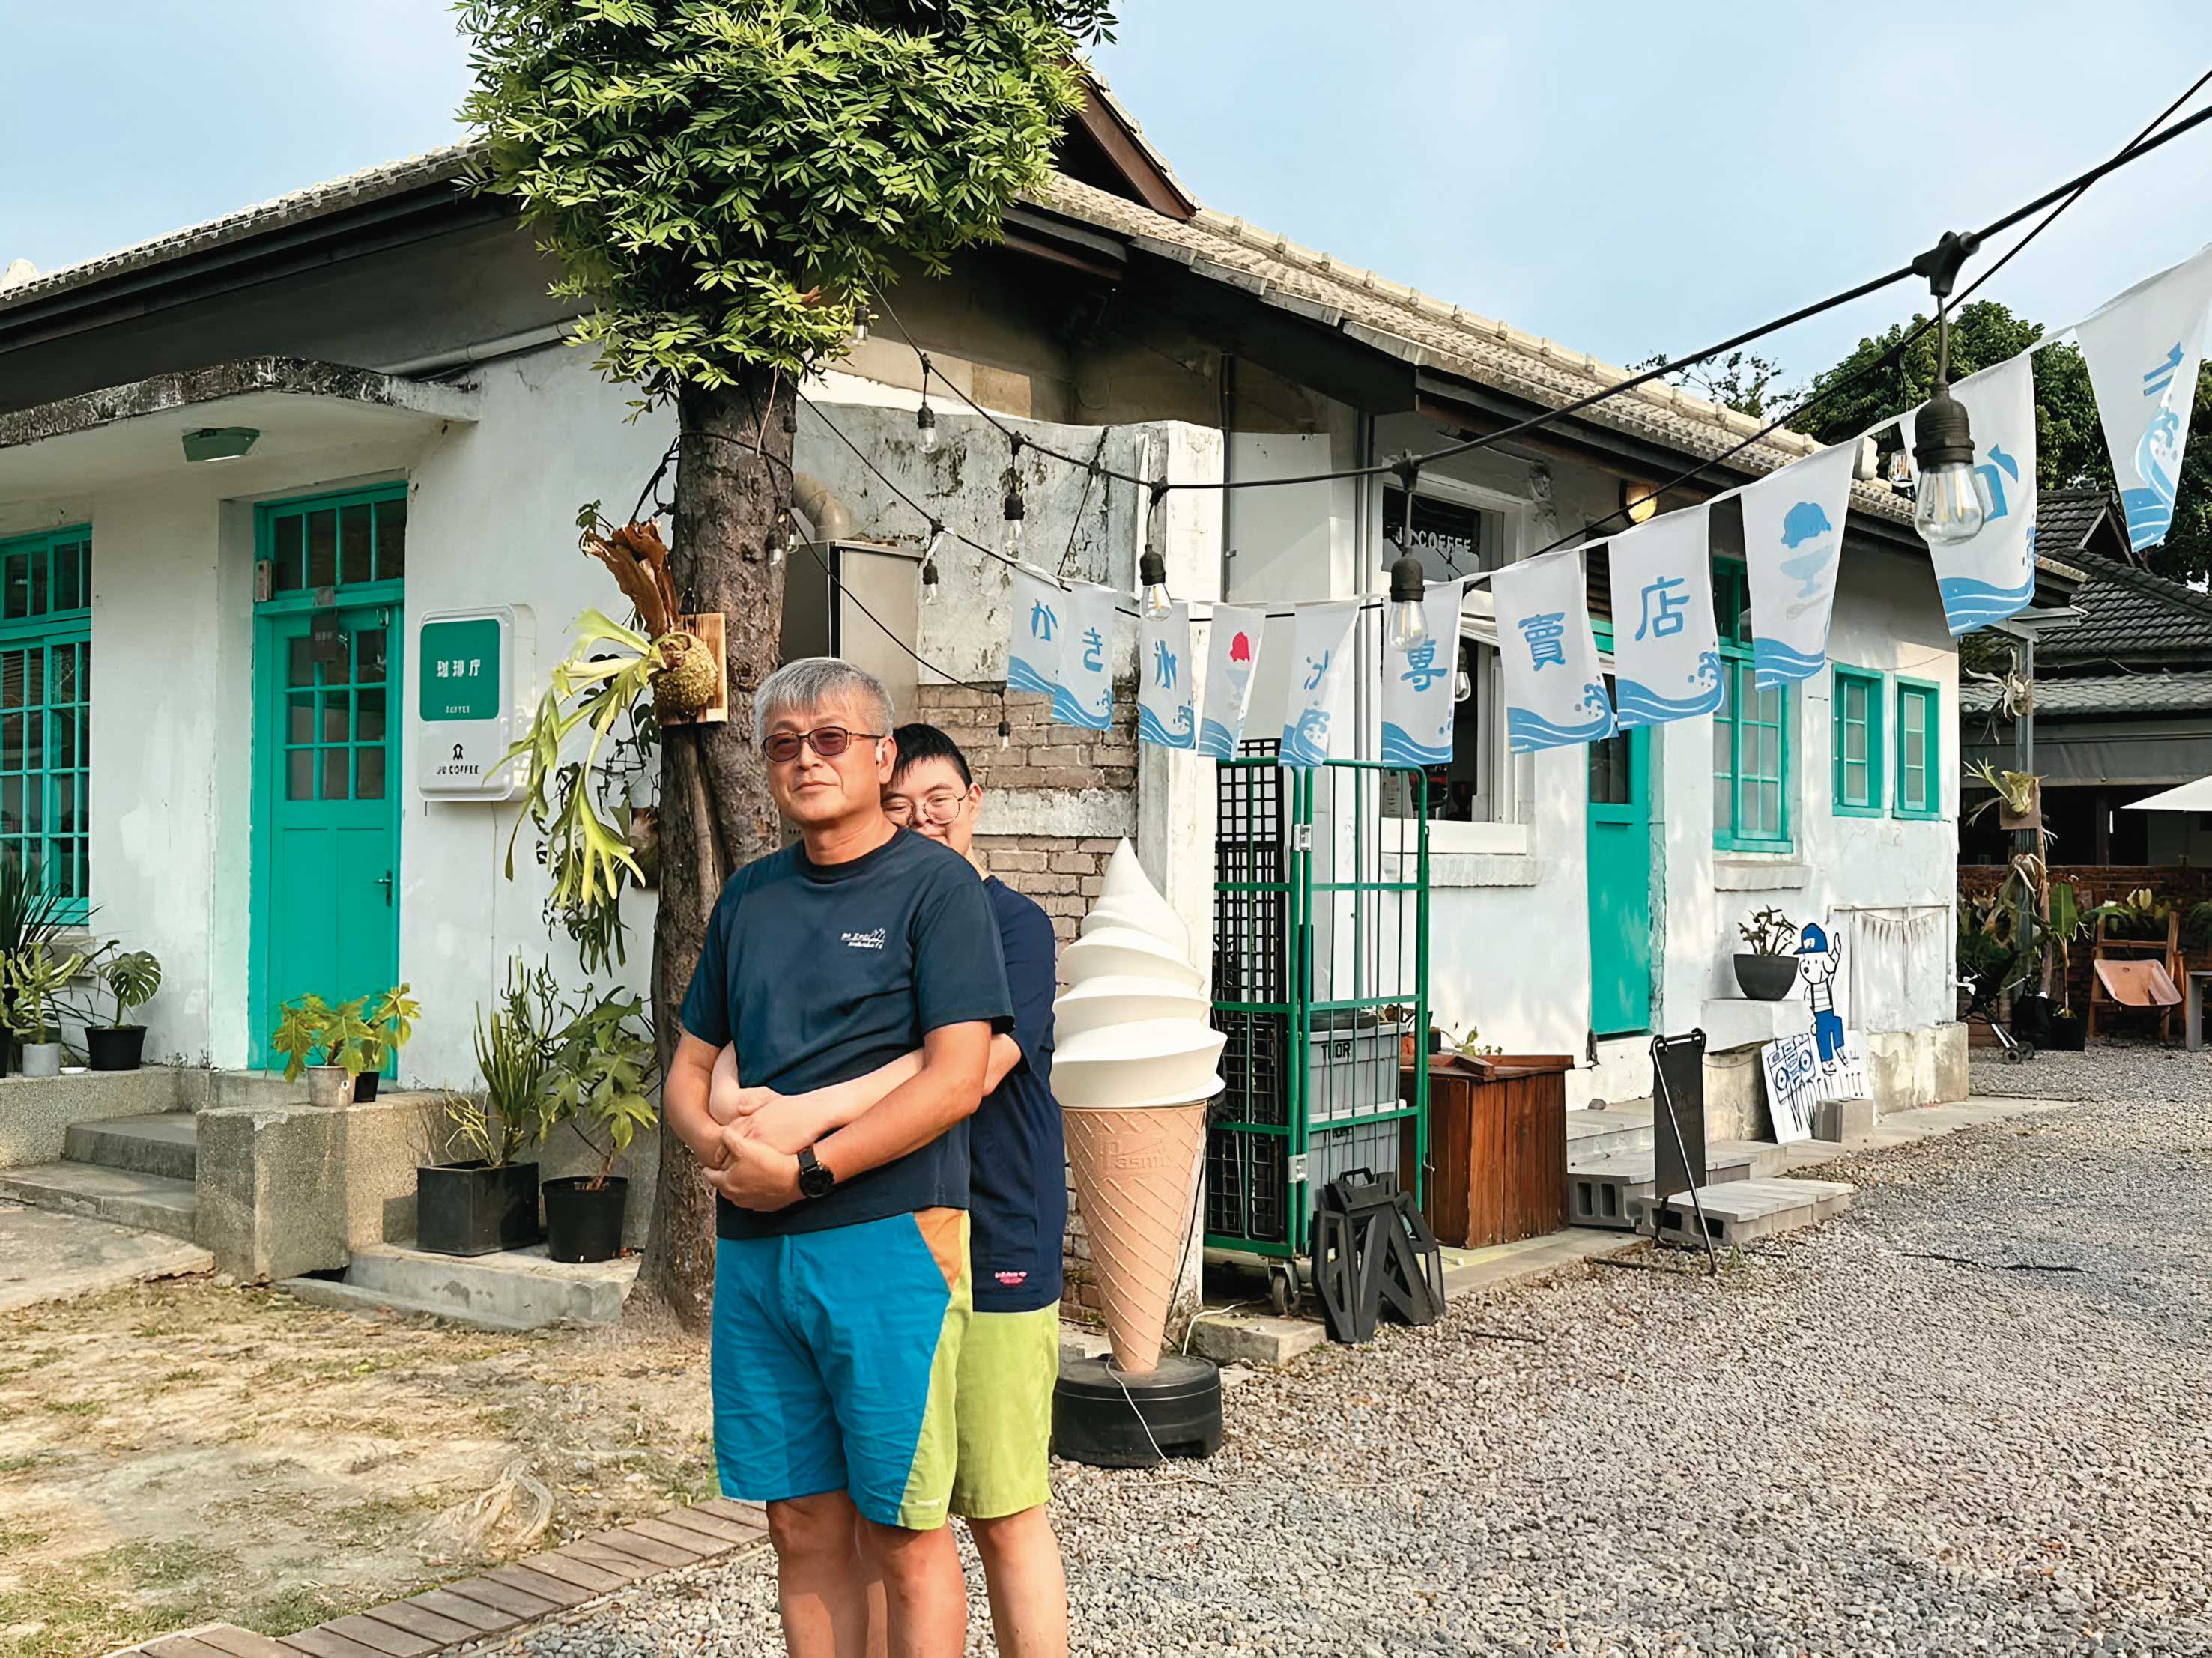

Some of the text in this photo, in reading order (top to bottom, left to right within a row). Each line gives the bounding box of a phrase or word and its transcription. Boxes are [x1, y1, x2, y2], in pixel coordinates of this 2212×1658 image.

[1419, 530, 1471, 555] COFFEE
[1518, 611, 1566, 672] 賣
[1635, 576, 1690, 641] 店
[1082, 627, 1103, 672] き
[449, 765, 479, 775] COFFEE
